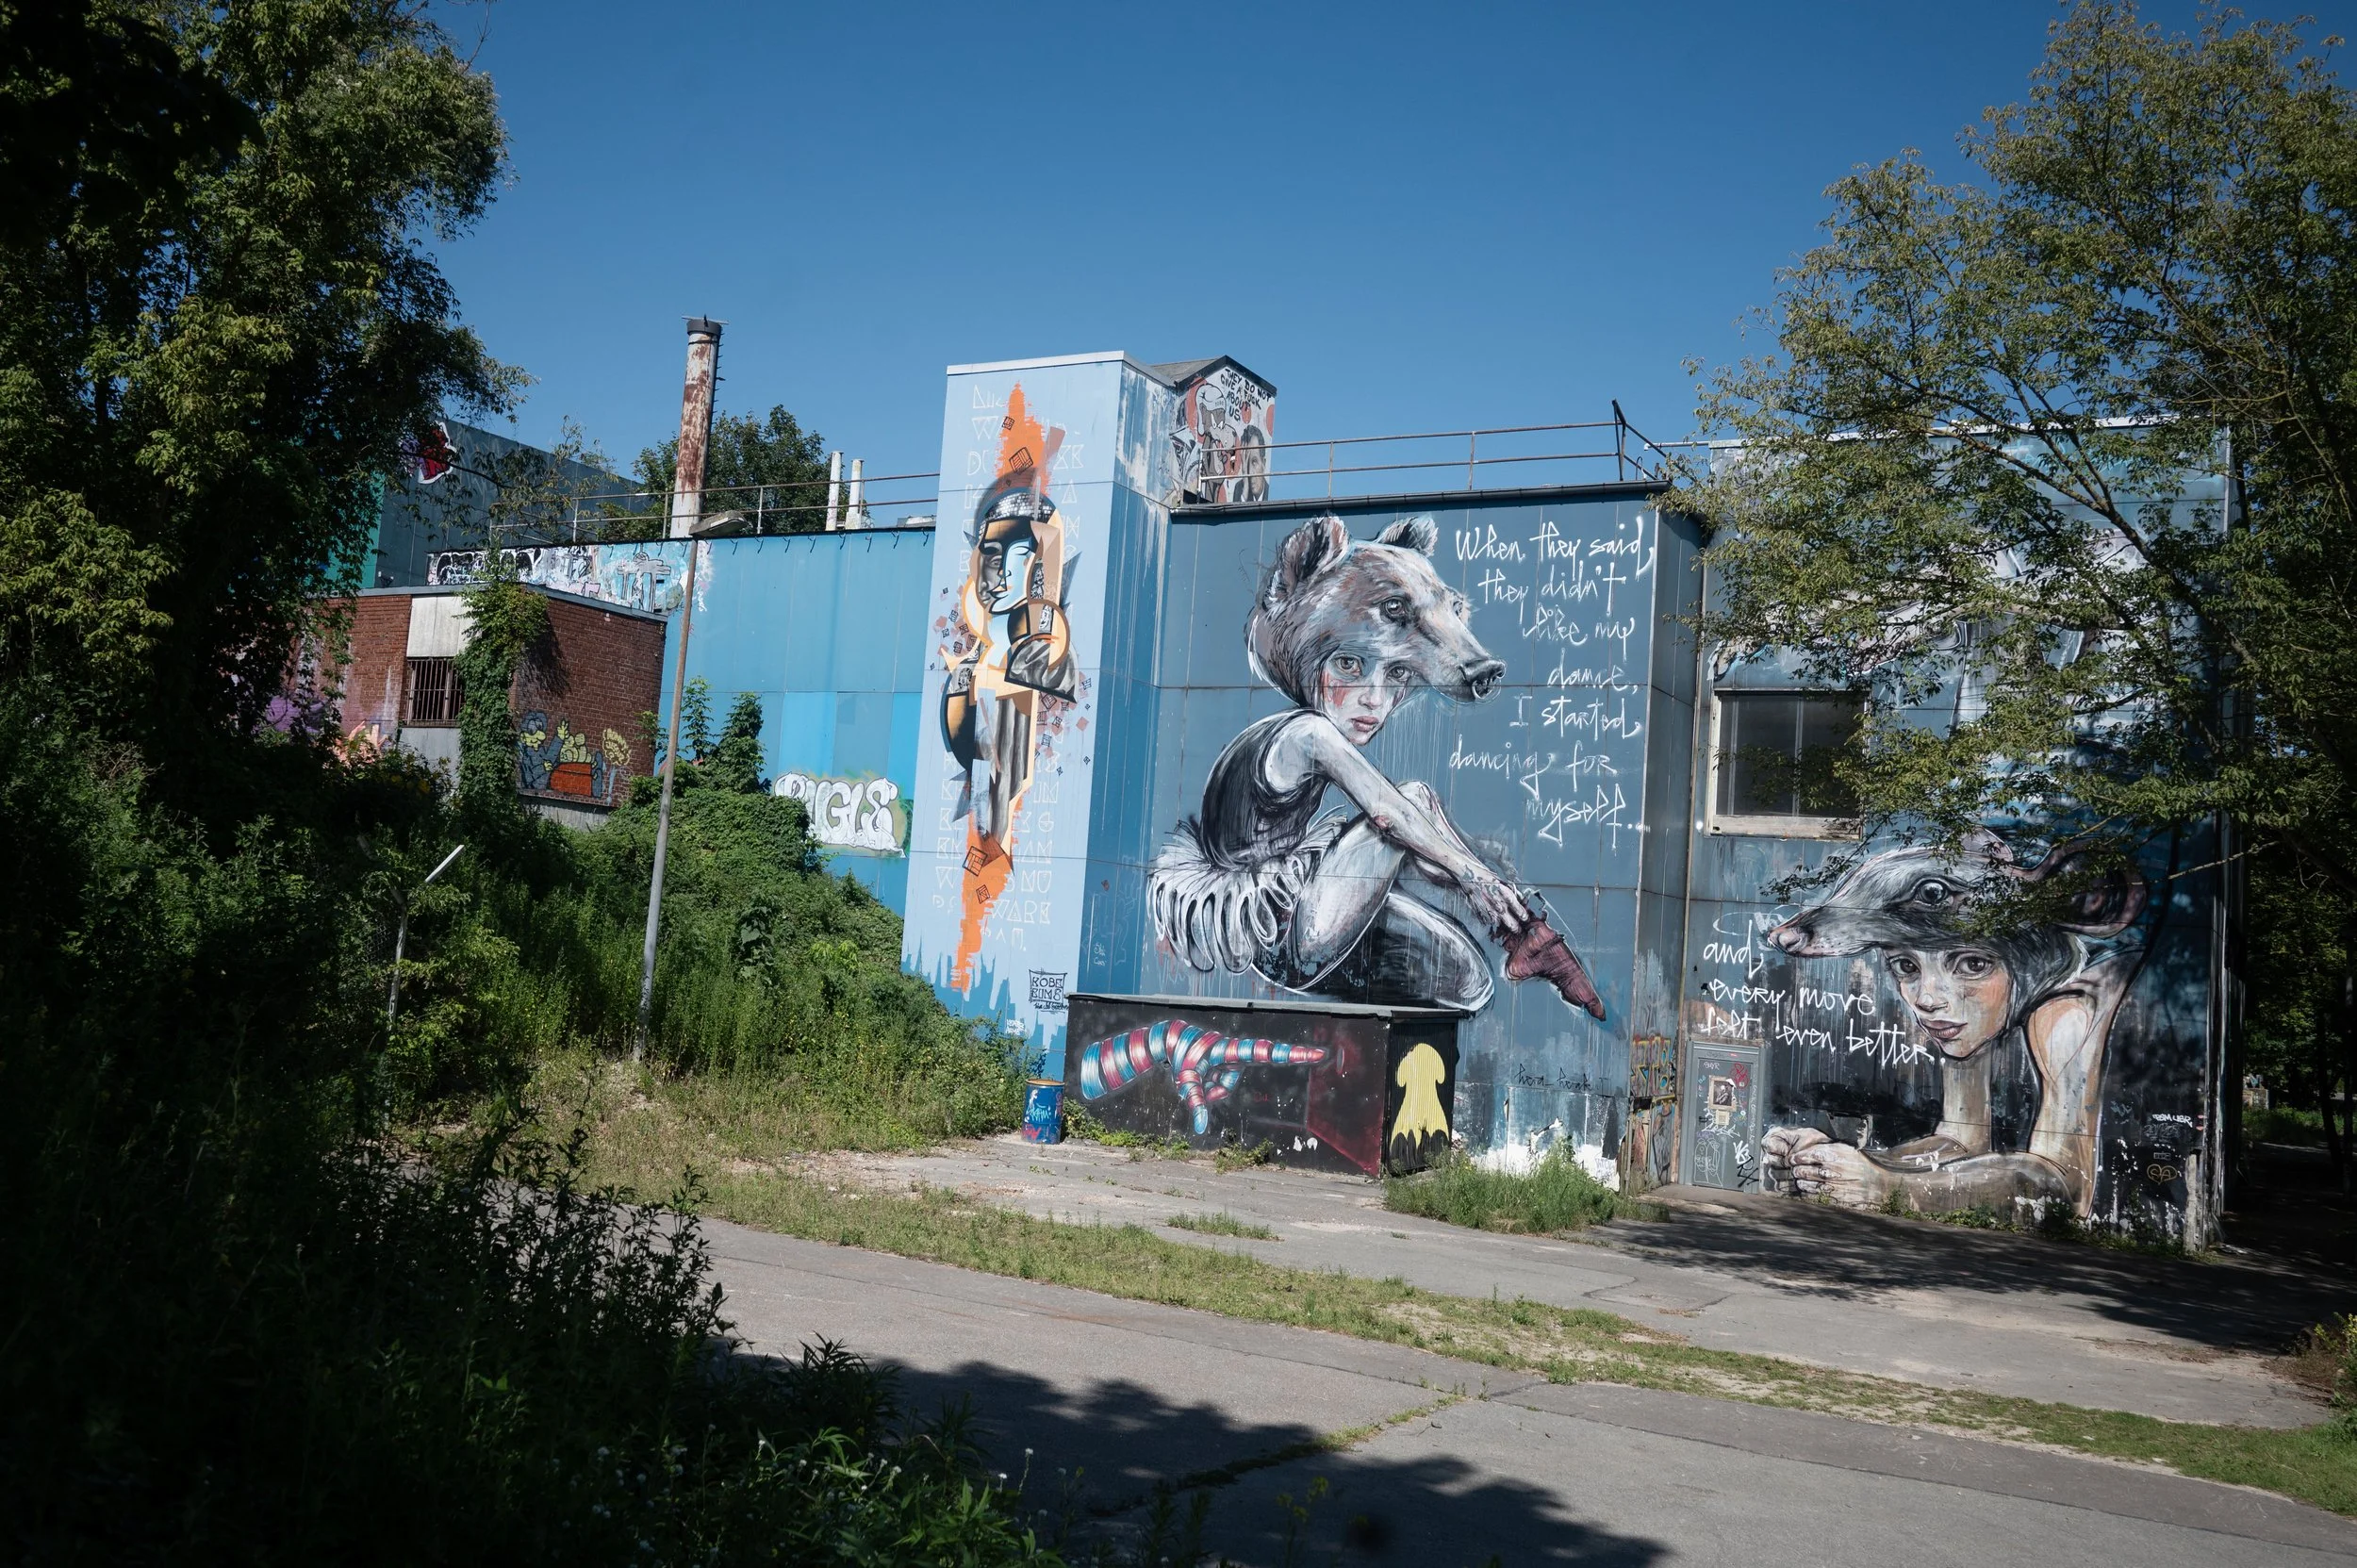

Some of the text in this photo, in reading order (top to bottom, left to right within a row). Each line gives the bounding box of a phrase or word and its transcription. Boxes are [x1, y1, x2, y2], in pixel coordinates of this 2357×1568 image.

[1220, 373, 1236, 390] GIVE
[1244, 388, 1261, 410] FUCK
[1225, 369, 1272, 403] THEY DO NOT
[1226, 390, 1251, 411] ABOUT
[1228, 405, 1241, 422] US
[1456, 523, 1525, 564] When
[1529, 520, 1582, 582] they
[1477, 559, 1627, 625] they didn't
[1523, 602, 1636, 663] like my
[1509, 692, 1533, 727] I
[1449, 734, 1555, 801] dancing
[1031, 976, 1063, 989] KOBE
[1708, 977, 1876, 1032] every move
[1700, 1006, 1947, 1071] felt even better.
